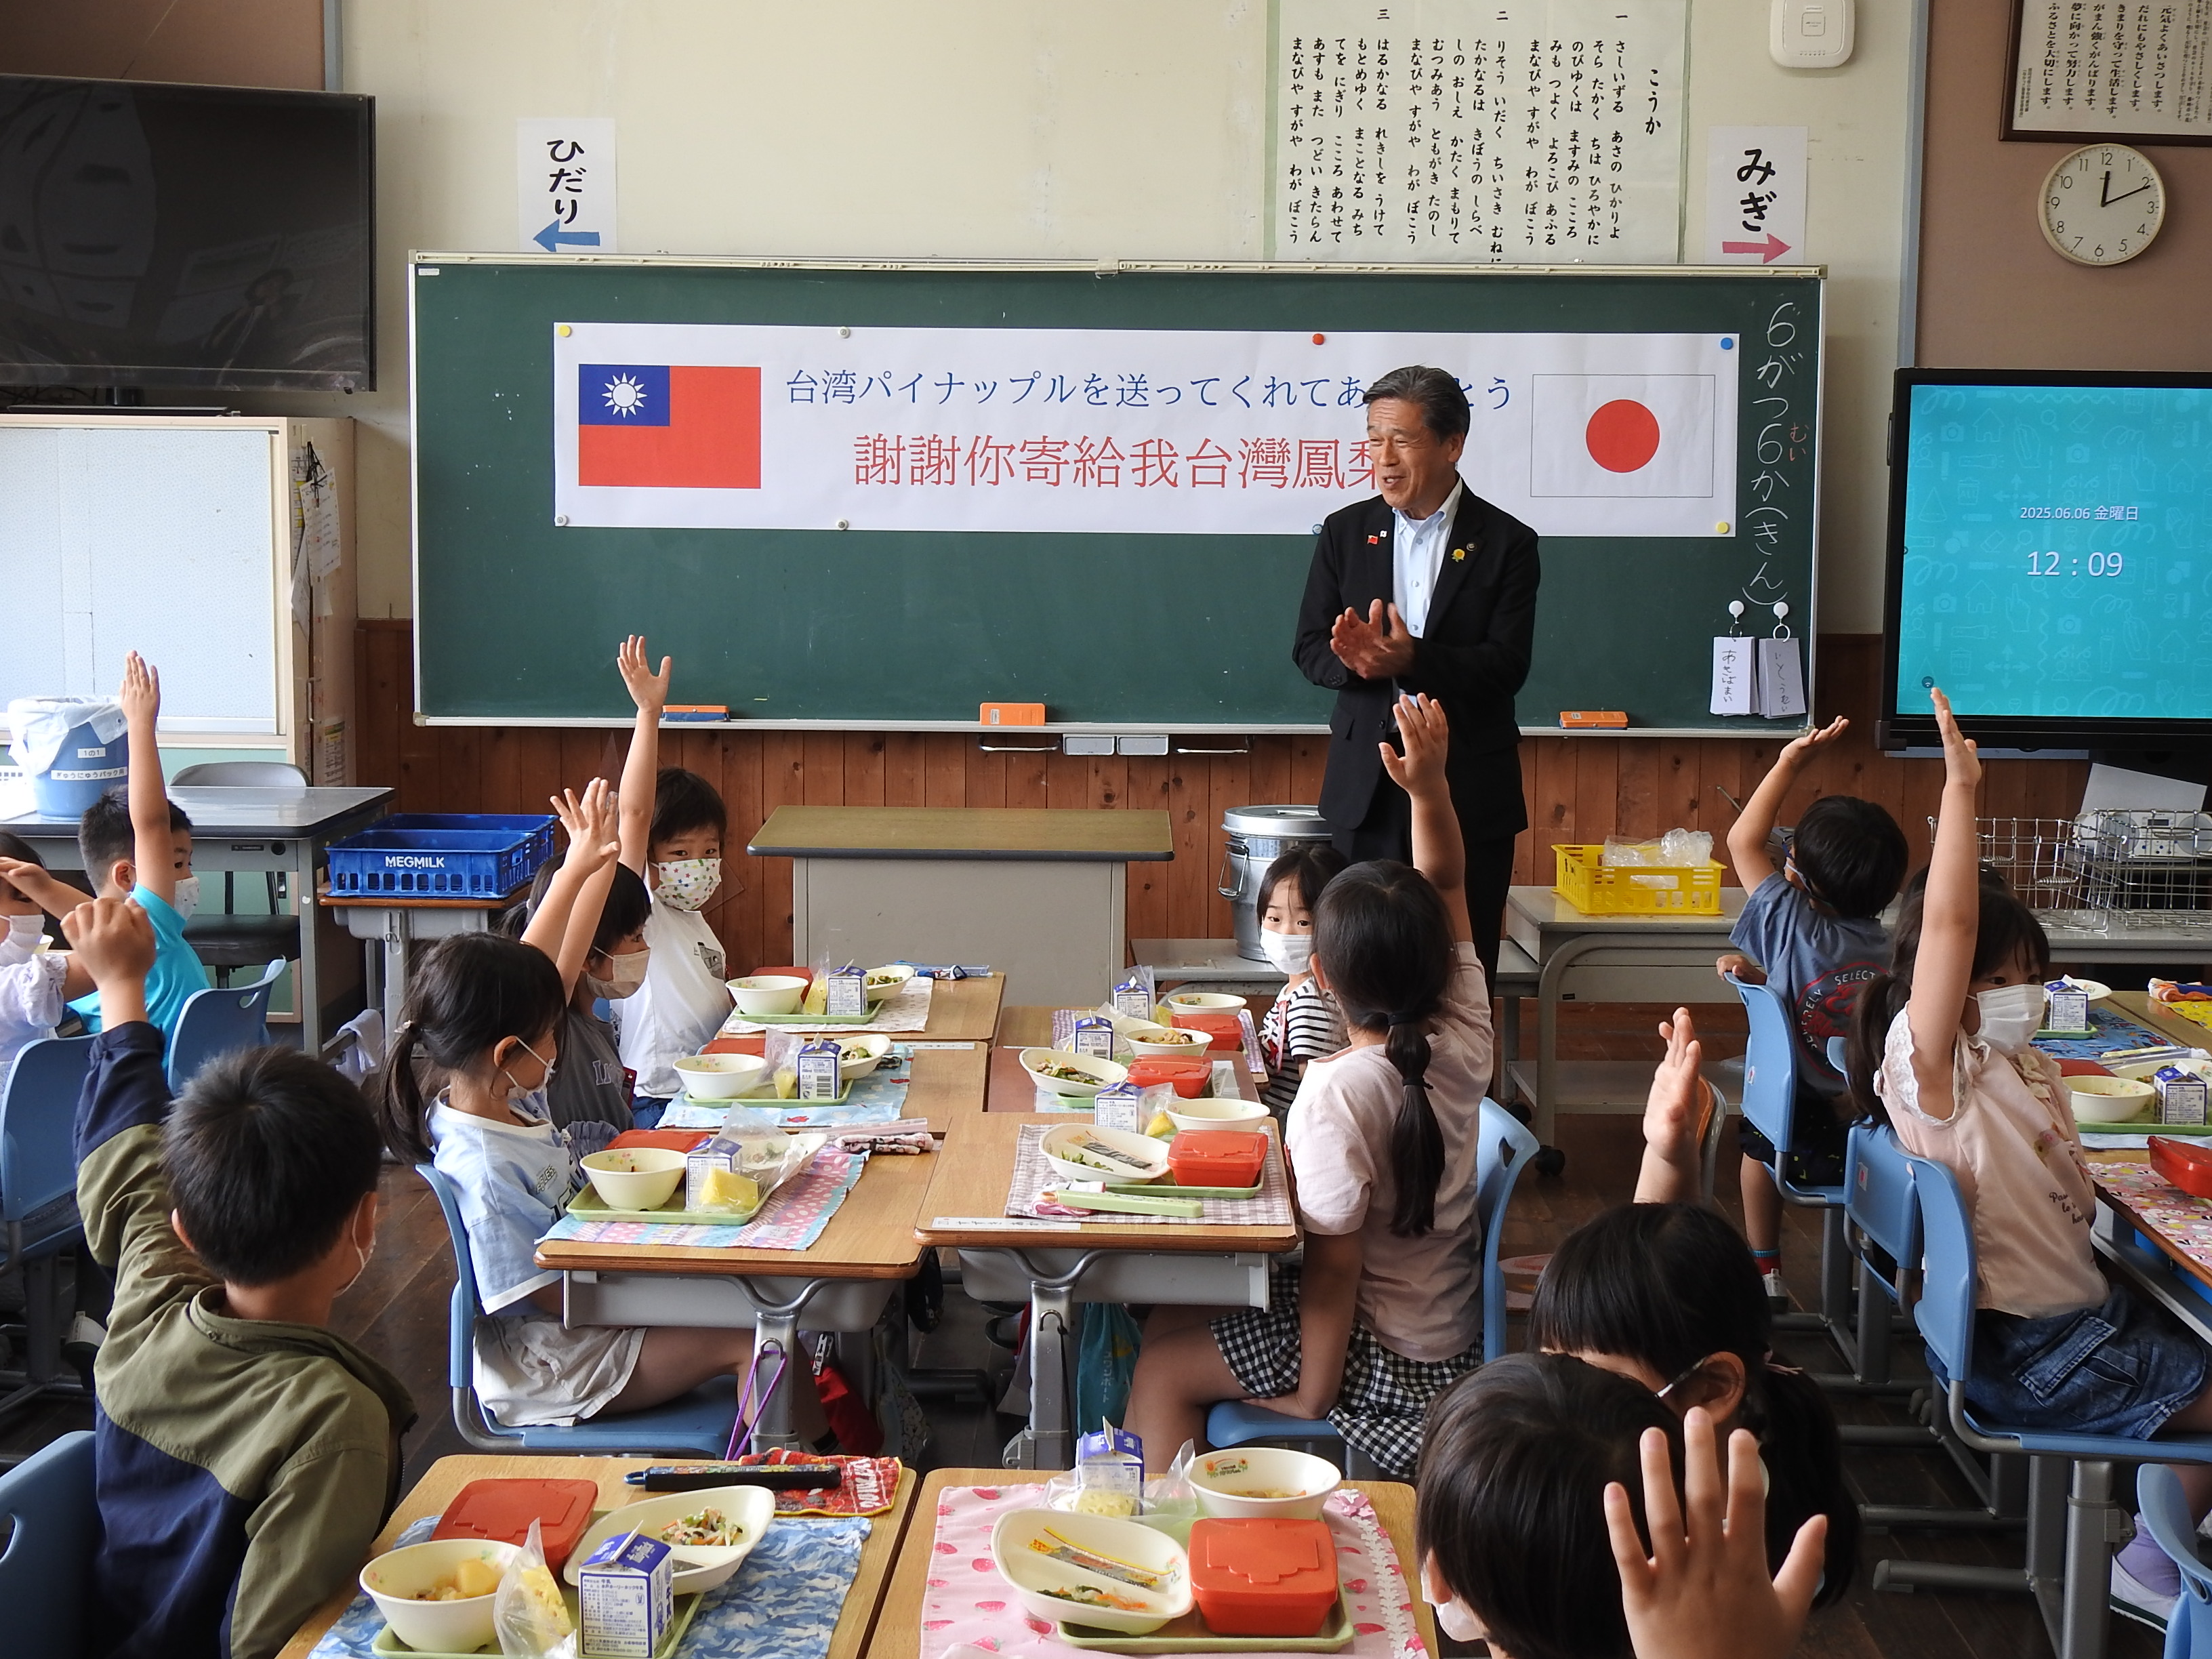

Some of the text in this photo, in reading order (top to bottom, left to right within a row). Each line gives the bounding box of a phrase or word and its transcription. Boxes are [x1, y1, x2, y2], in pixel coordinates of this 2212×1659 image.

[1376, 9, 1390, 20] 三
[1496, 11, 1509, 20] 二
[1494, 40, 1507, 85] りそう
[1493, 96, 1507, 139] いだく
[1644, 68, 1662, 136] こうか
[1288, 37, 1305, 244] まなびや すがや わが ぼこう
[1309, 37, 1326, 243] あすも また つどい きたらん
[1329, 38, 1347, 243] てを にぎり こころ あわせて
[1351, 37, 1368, 237] もとめゆく まことなる みち
[1372, 38, 1391, 237] はるかなる れきしを うけて
[1406, 38, 1424, 245] まなびや すがや わが ぼこう
[1427, 38, 1446, 237] むつみあう ともがき たのし
[1448, 38, 1466, 244] しの おしえ かたく まもりて
[1469, 39, 1488, 234] たかなるは きぼうの しらべ
[1524, 39, 1542, 246] まなびや すがや わが ぼこう
[1543, 39, 1563, 245] みも つよく よろこび あふる
[1565, 41, 1585, 239] のびゆくは ますみの こころ
[1586, 40, 1605, 245] そら たかく ちは ひろやかに
[1608, 40, 1627, 239] さしいずる あさの ひかりよ
[2101, 152, 2113, 165] 12
[546, 140, 587, 224] ひだり
[1491, 156, 1504, 216] ちいさき
[2060, 176, 2073, 189] 10
[2079, 158, 2089, 171] 11
[2127, 159, 2131, 172] 1
[1736, 148, 1776, 233] みぎ
[2051, 197, 2060, 209] 9
[2146, 201, 2155, 214] 3
[2056, 220, 2064, 234] 8
[2074, 237, 2084, 249] 7
[2118, 239, 2128, 252] 5
[2136, 223, 2146, 235] 4
[2094, 244, 2104, 258] 6
[2020, 505, 2139, 521] 2025.06.06 金曜日
[83, 749, 100, 758] 1の1
[385, 855, 445, 869] MEGMILK
[1834, 970, 1876, 985] SELECT
